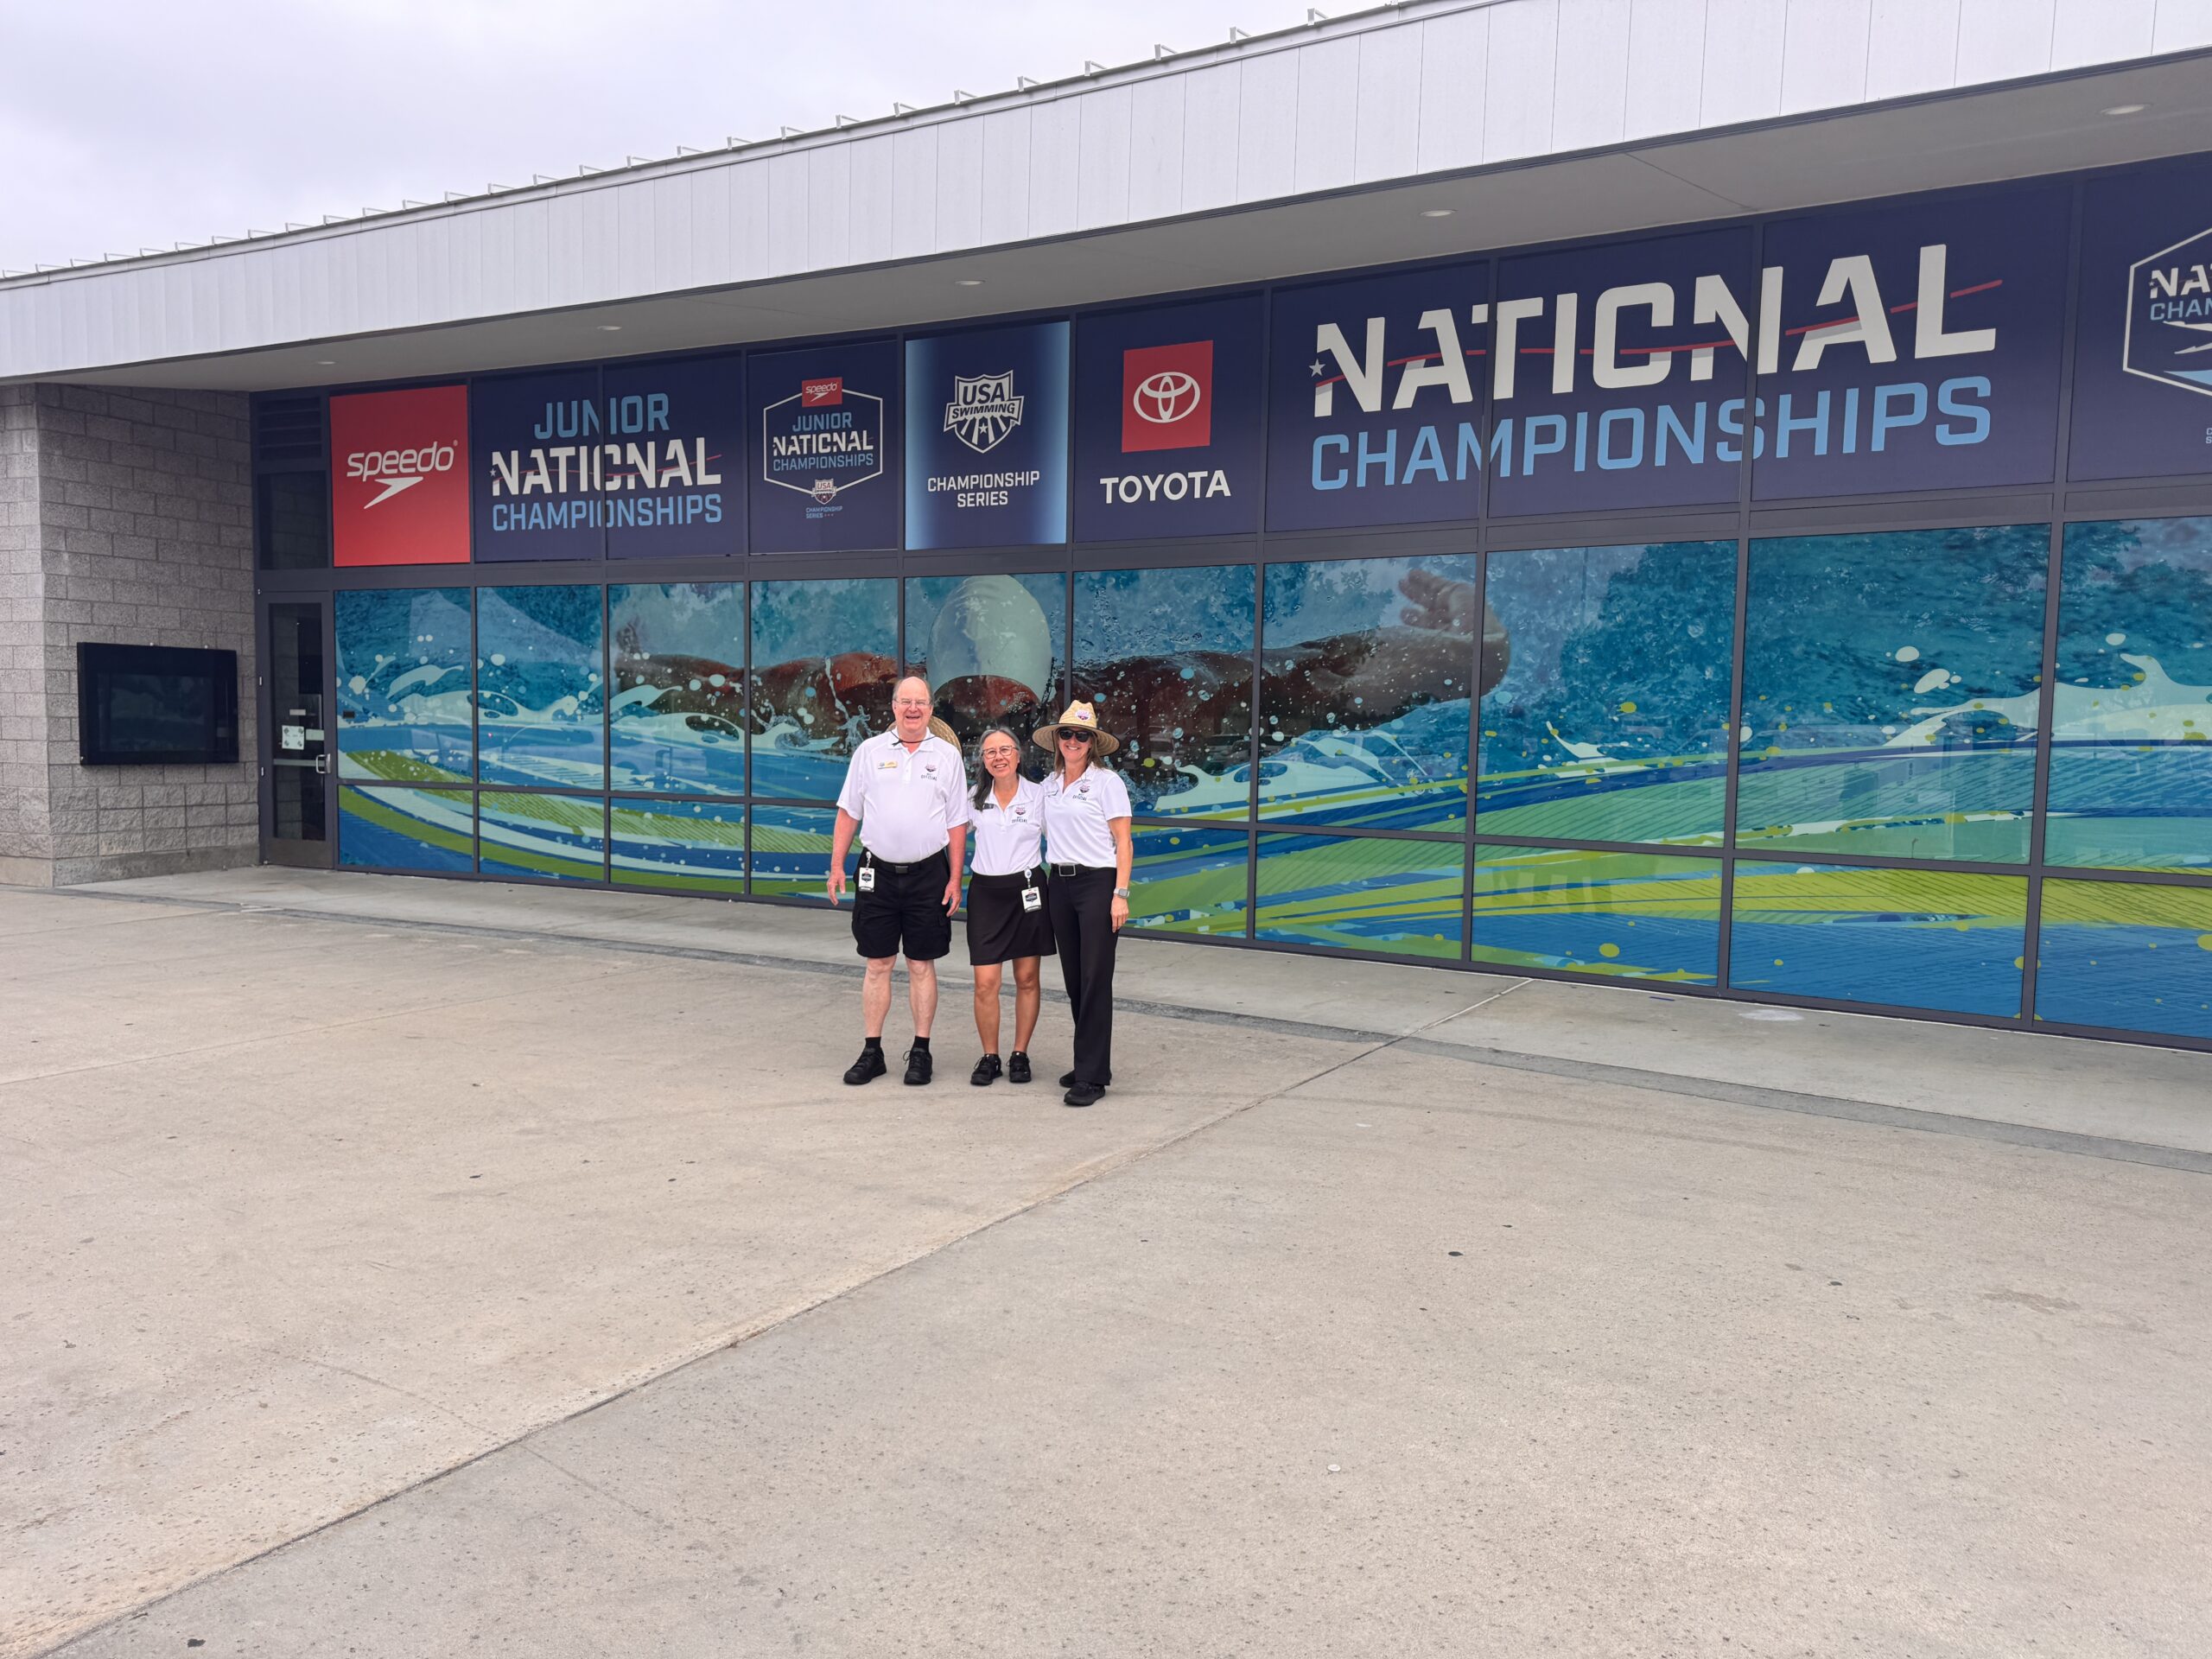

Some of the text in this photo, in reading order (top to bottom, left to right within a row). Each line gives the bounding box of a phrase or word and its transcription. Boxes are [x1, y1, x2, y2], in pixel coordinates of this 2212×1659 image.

[2150, 264, 2212, 299] NA
[1313, 244, 1996, 417] NATIONAL
[805, 382, 837, 394] speedo
[962, 382, 1006, 406] USA
[533, 393, 670, 439] JUNIOR
[792, 412, 852, 432] JUNIOR
[951, 402, 1016, 419] SWIMMING
[772, 430, 874, 456] NATIONAL
[1311, 375, 1992, 491] CHAMPIONSHIPS
[346, 441, 455, 481] speedo
[492, 437, 721, 496] NATIONAL
[772, 453, 874, 472] CHAMPIONSHIPS
[927, 471, 1039, 492] CHAMPIONSHIP
[1100, 469, 1231, 504] TOYOTA
[492, 494, 721, 531] CHAMPIONSHIPS
[957, 491, 1008, 507] SERIES
